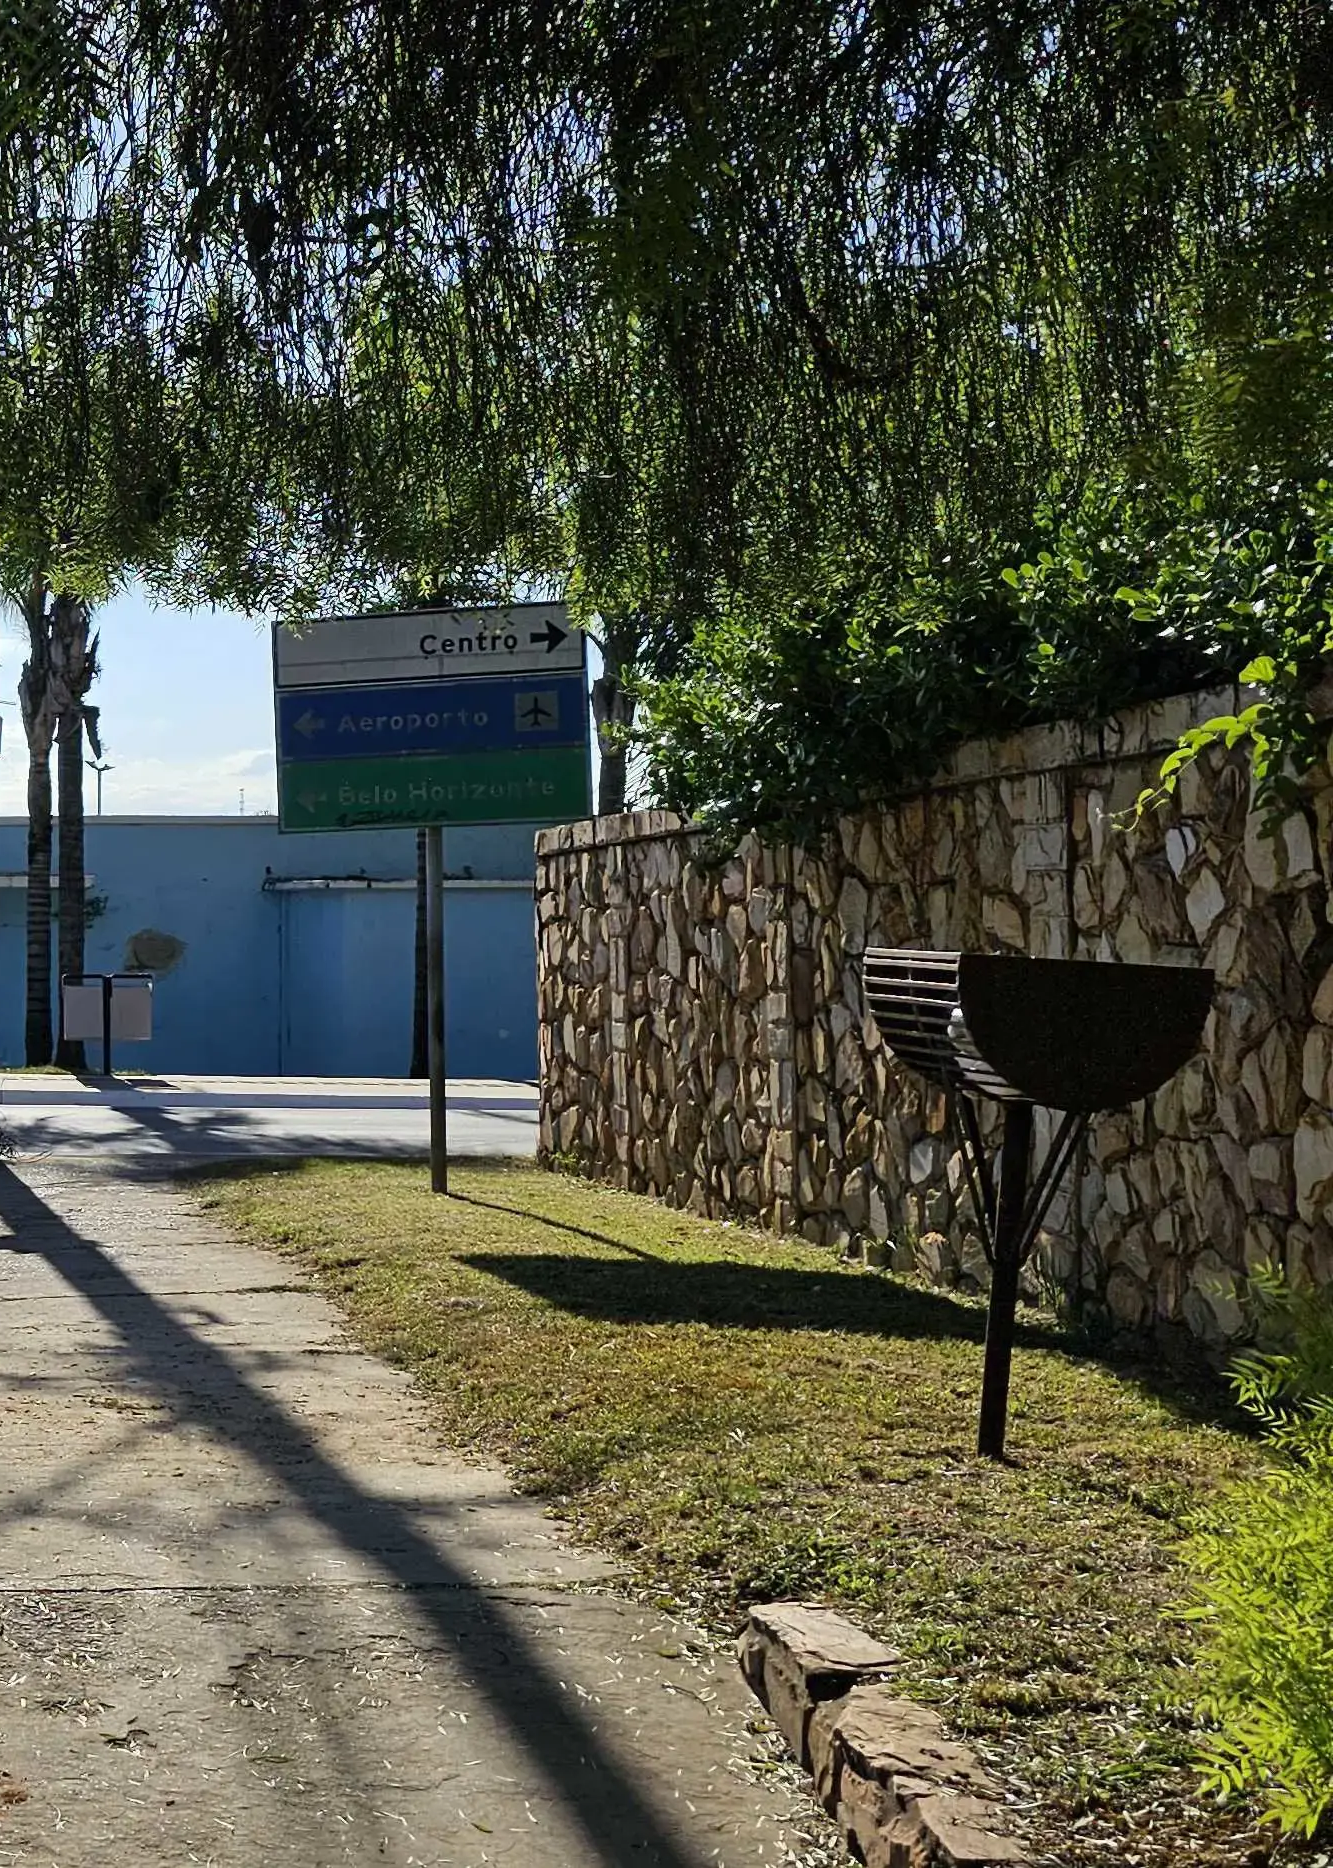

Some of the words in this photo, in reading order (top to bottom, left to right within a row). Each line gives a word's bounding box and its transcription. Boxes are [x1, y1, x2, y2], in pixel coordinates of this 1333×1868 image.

[420, 631, 518, 655] Centro
[338, 708, 488, 733] Aeroporto
[338, 784, 397, 806] Belo
[408, 778, 555, 802] Horizonte
